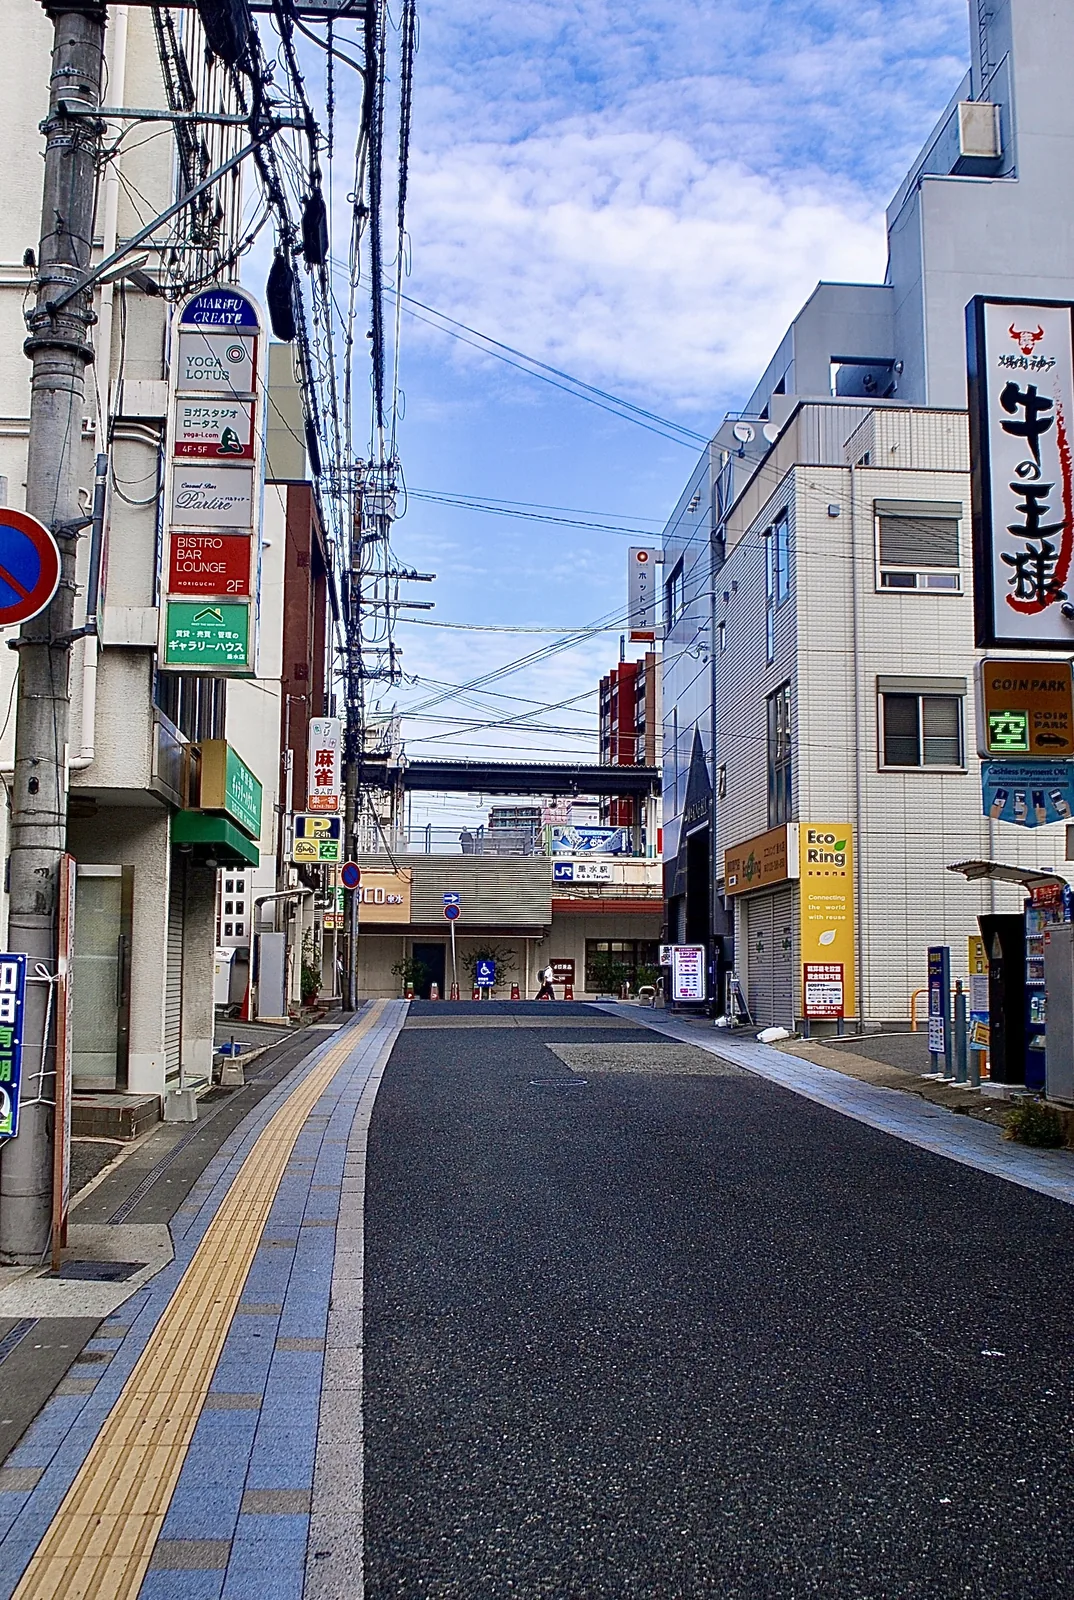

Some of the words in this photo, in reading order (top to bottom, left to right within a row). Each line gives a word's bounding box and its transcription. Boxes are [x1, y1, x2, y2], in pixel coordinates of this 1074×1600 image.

[194, 311, 242, 324] CREATE
[186, 357, 222, 368] YOGA
[185, 370, 230, 381] LOTUS
[184, 408, 238, 419] ヨガスタジオ
[184, 420, 219, 429] ロータス
[1000, 381, 1069, 609] 牛の王様
[177, 537, 223, 549] BISTRO
[177, 549, 202, 560] BAR
[176, 561, 227, 573] LOUNGE
[226, 580, 244, 592] 2F
[168, 640, 244, 652] ギャラリーハウス
[991, 678, 1029, 691] COIN
[1031, 679, 1066, 692] PARK
[1034, 711, 1068, 720] COIN
[989, 712, 1027, 750] 空
[1034, 721, 1068, 729] PARK
[314, 749, 334, 786] 麻雀
[1020, 768, 1053, 777] Payment
[1053, 768, 1069, 776] OK!
[304, 817, 332, 838] P
[807, 829, 836, 844] Eco
[807, 848, 846, 867] Ring
[555, 866, 572, 877] JR
[808, 894, 846, 902] Connecting
